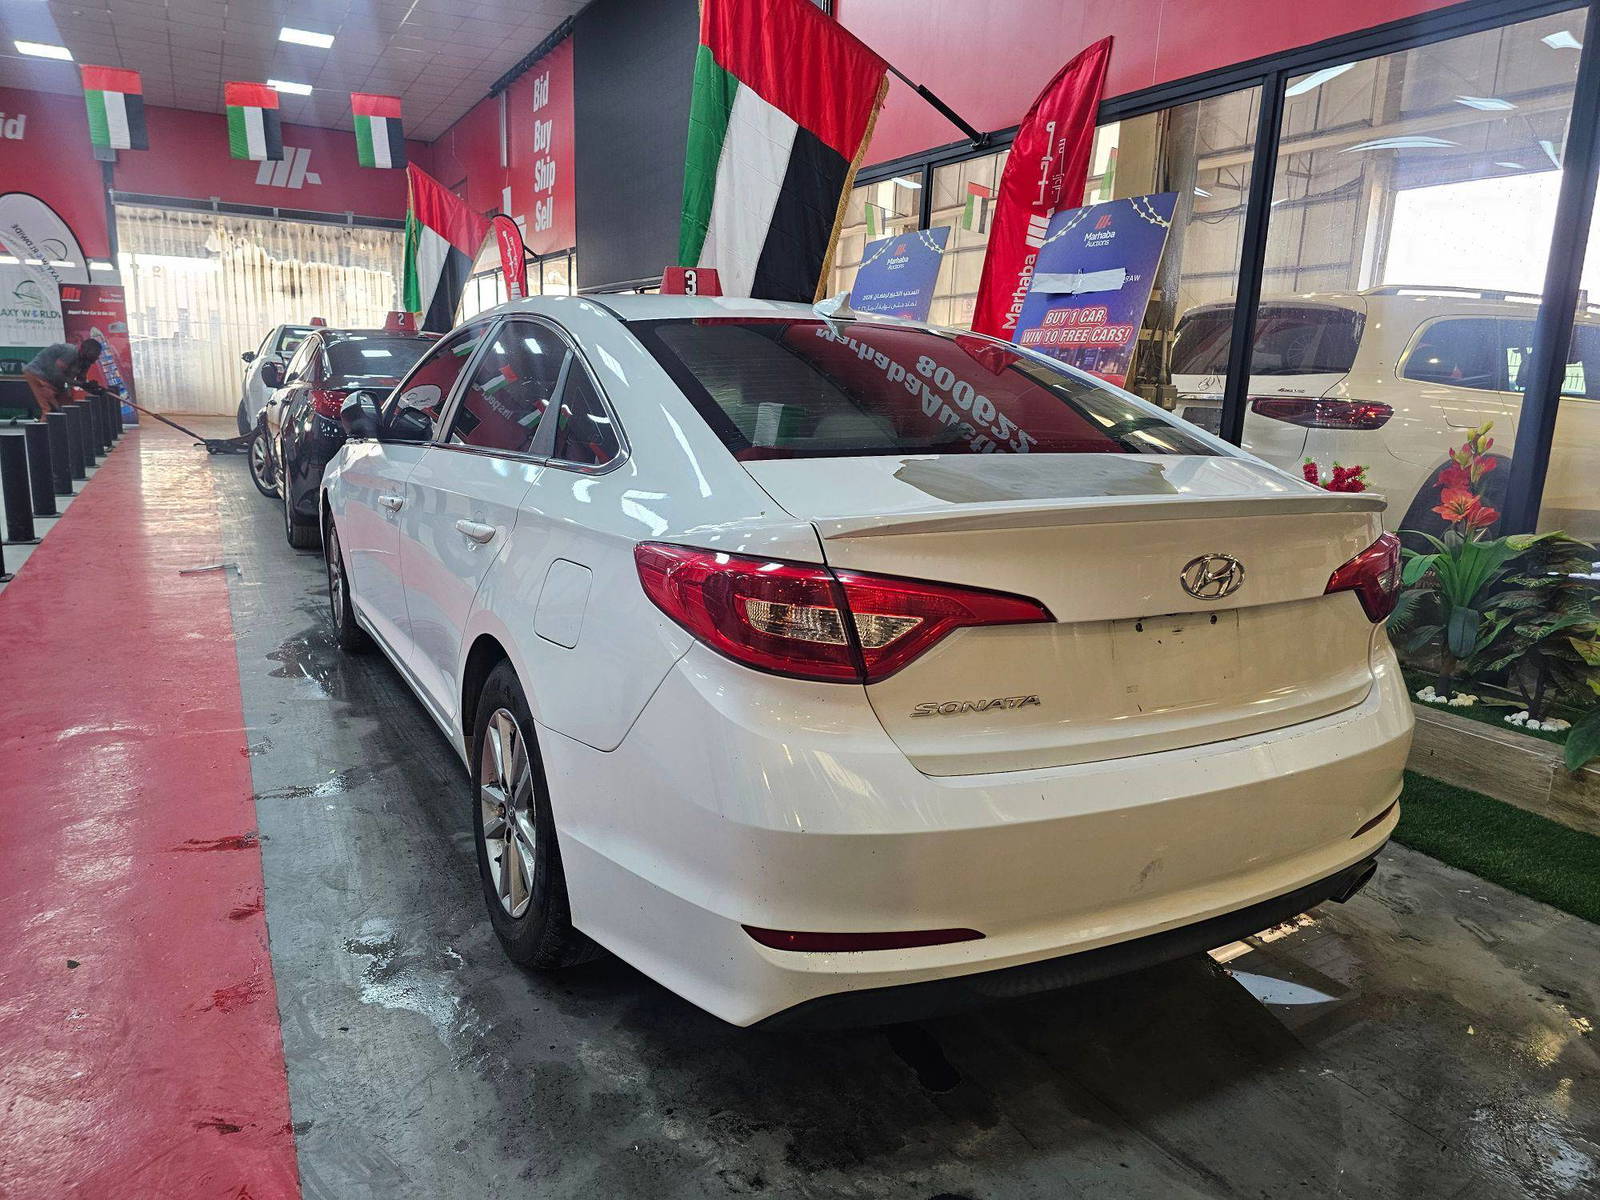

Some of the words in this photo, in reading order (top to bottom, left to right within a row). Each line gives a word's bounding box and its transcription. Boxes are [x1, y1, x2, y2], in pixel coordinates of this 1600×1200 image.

[533, 71, 549, 112] Bid
[534, 119, 552, 153] Buy
[534, 155, 555, 194] Ship
[534, 196, 553, 232] Sell
[1084, 230, 1116, 242] Marhaba
[1084, 239, 1111, 249] Auctions
[684, 270, 697, 296] 3
[1124, 274, 1141, 283] RAW
[1001, 252, 1037, 330] Marhaba
[397, 312, 405, 326] 2
[1046, 311, 1069, 325] BUY
[1070, 310, 1077, 323] 1
[1079, 308, 1106, 324] CAR,
[1022, 330, 1042, 344] WIN
[1045, 331, 1058, 342] 10
[1060, 330, 1091, 342] FREE
[1093, 329, 1131, 343] CARS!
[909, 694, 1041, 718] SONATA
